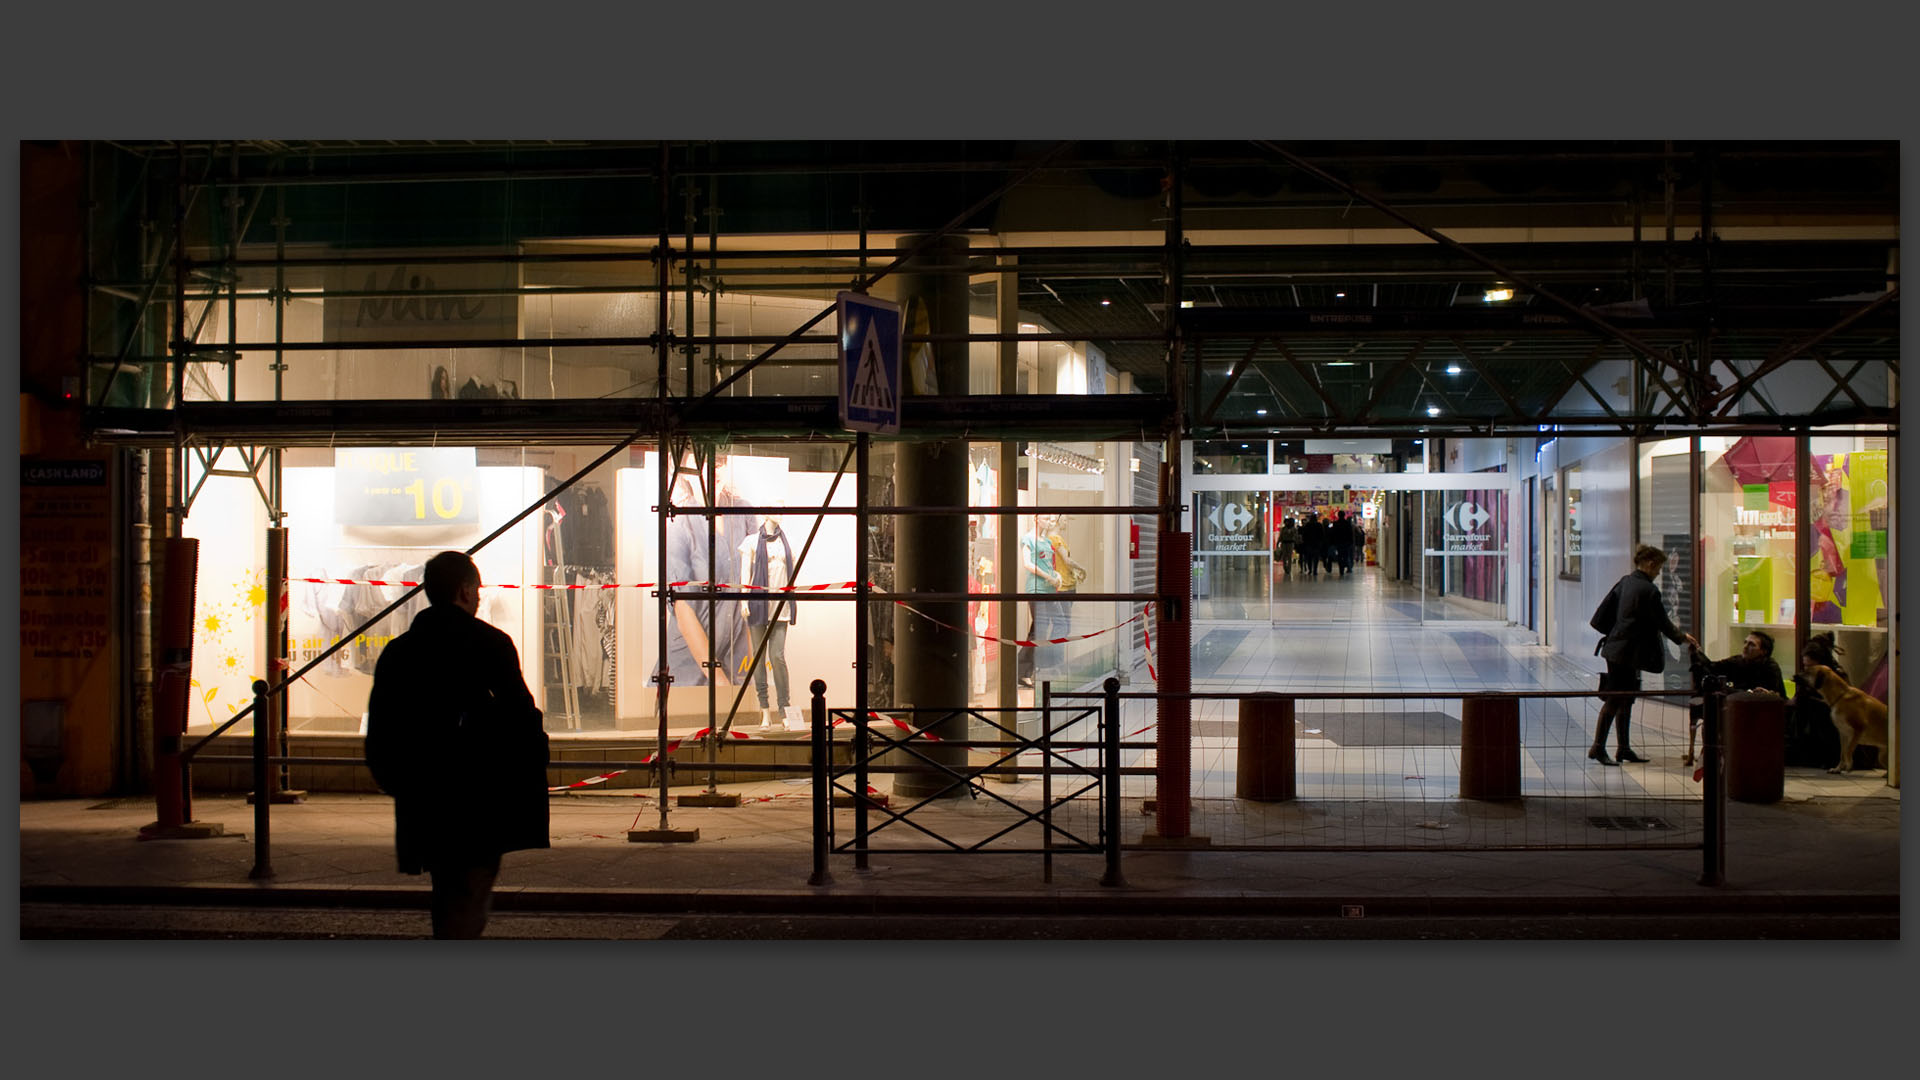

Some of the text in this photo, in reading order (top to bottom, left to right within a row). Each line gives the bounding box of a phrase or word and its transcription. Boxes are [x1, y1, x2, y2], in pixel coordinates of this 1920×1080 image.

[405, 478, 464, 520] 10
[1208, 533, 1255, 542] Carrefour
[1215, 543, 1248, 552] market
[1450, 543, 1484, 552] market
[302, 634, 325, 650] air
